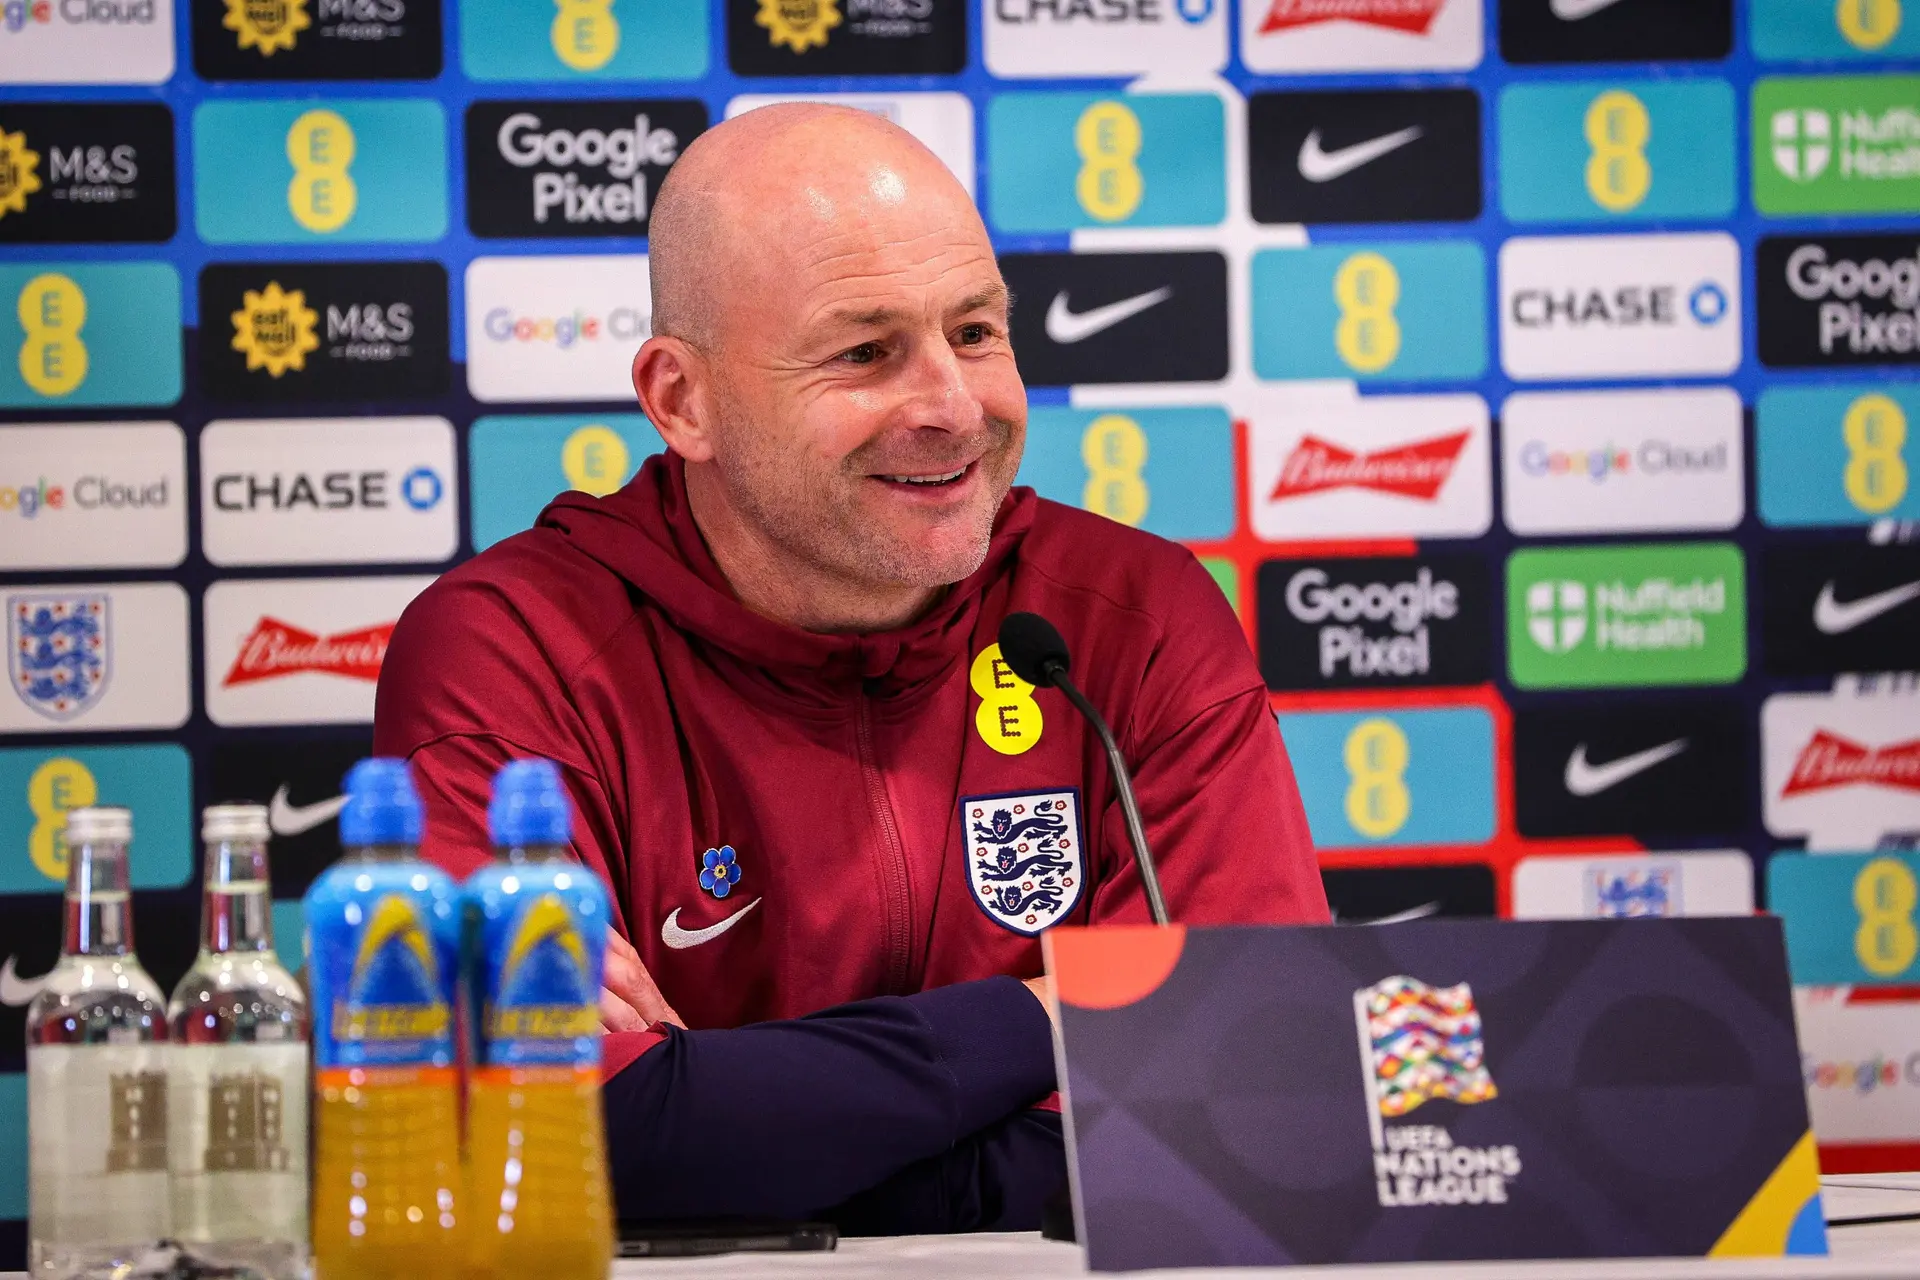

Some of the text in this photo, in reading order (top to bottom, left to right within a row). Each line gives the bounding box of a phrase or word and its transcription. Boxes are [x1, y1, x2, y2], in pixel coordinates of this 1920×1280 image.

[0, 0, 51, 31] gle
[994, 0, 1164, 24] CHASE
[49, 145, 138, 184] M&S
[498, 113, 678, 177] Google
[533, 172, 648, 223] Pixel
[326, 302, 414, 342] M&S
[1511, 286, 1676, 327] CHASE
[485, 307, 598, 349] Google
[1518, 439, 1728, 485] Google Cloud
[73, 477, 168, 511] Cloud
[213, 471, 388, 511] CHASE
[1285, 566, 1459, 632] Google
[1319, 625, 1430, 677] Pixel
[1373, 1145, 1522, 1177] NATIONS
[1377, 1174, 1508, 1207] LEAGUE
